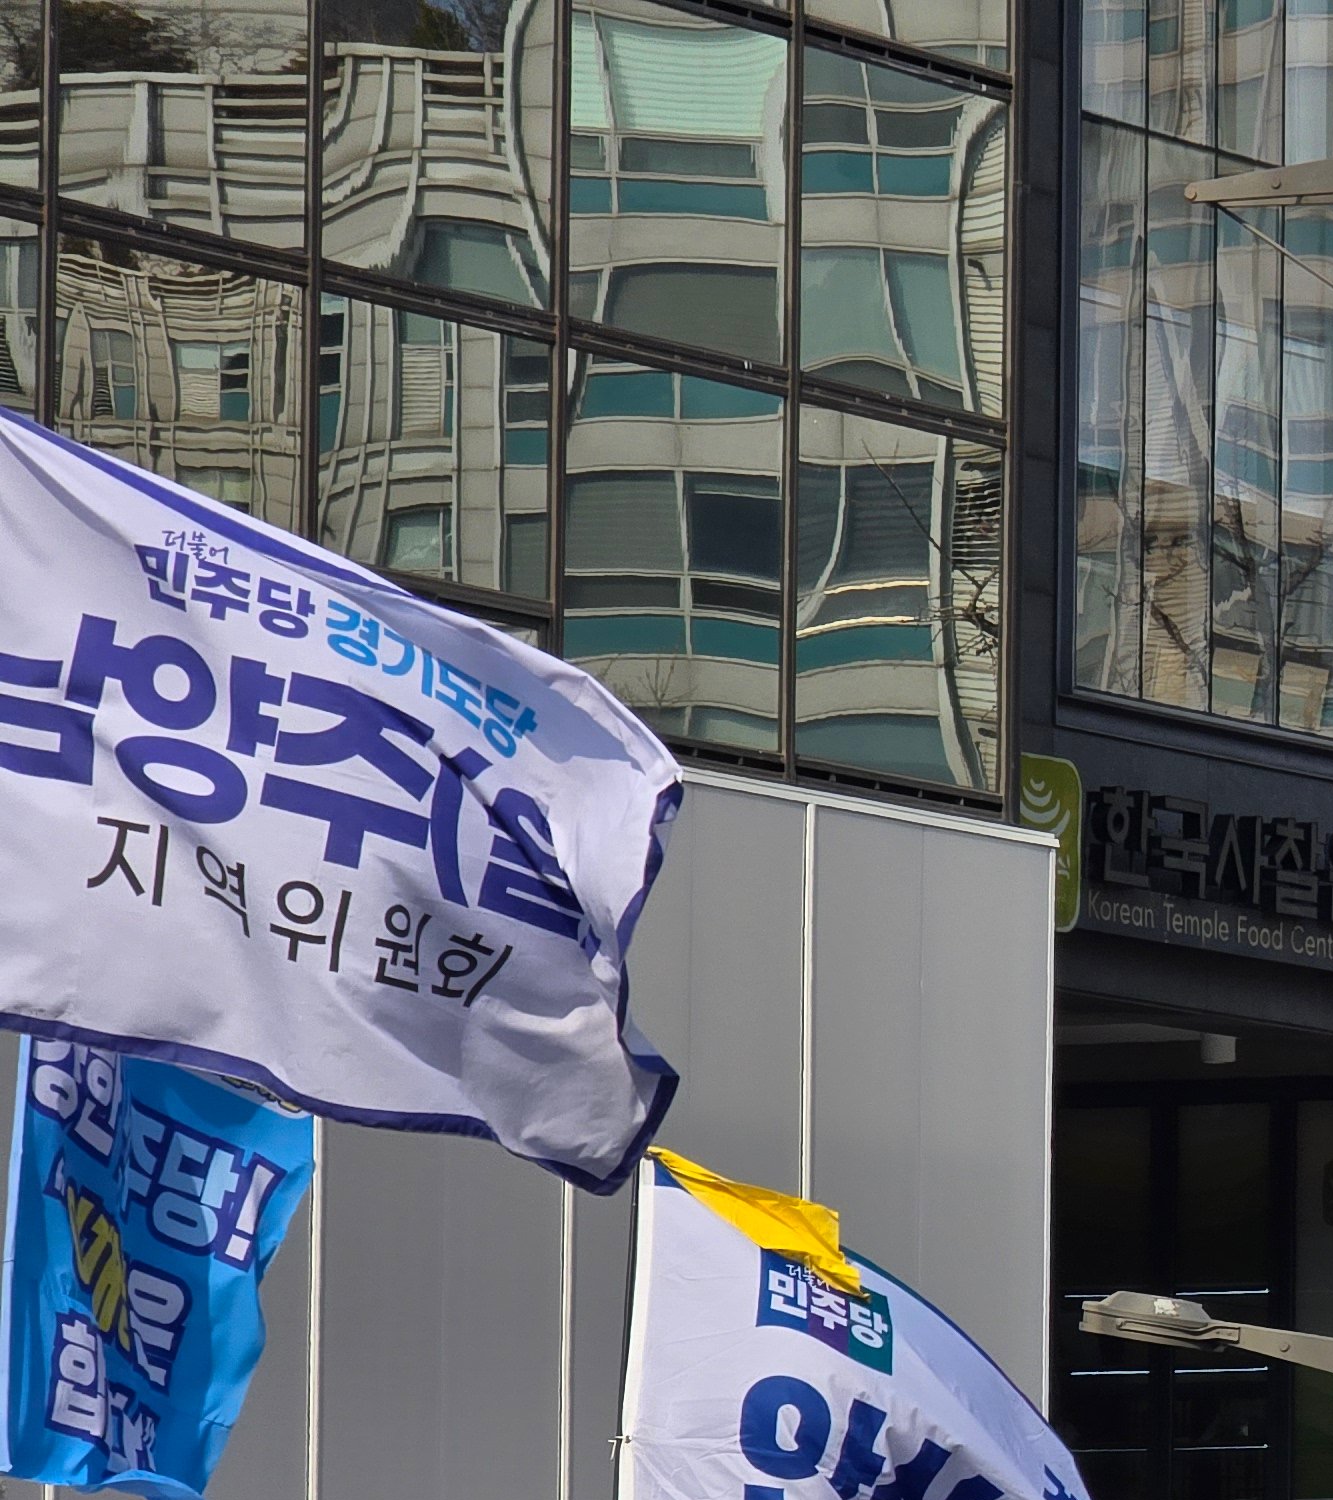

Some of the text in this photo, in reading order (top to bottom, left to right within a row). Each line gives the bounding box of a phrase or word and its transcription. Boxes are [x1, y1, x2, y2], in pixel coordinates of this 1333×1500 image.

[161, 529, 230, 563] 더불어
[134, 543, 538, 760] 민주당 경기도당
[86, 814, 514, 1008] 지역위원회
[1087, 890, 1155, 929] Korean
[1162, 900, 1230, 943] Temple
[1236, 912, 1284, 951] Food
[768, 1269, 889, 1349] 민주당
